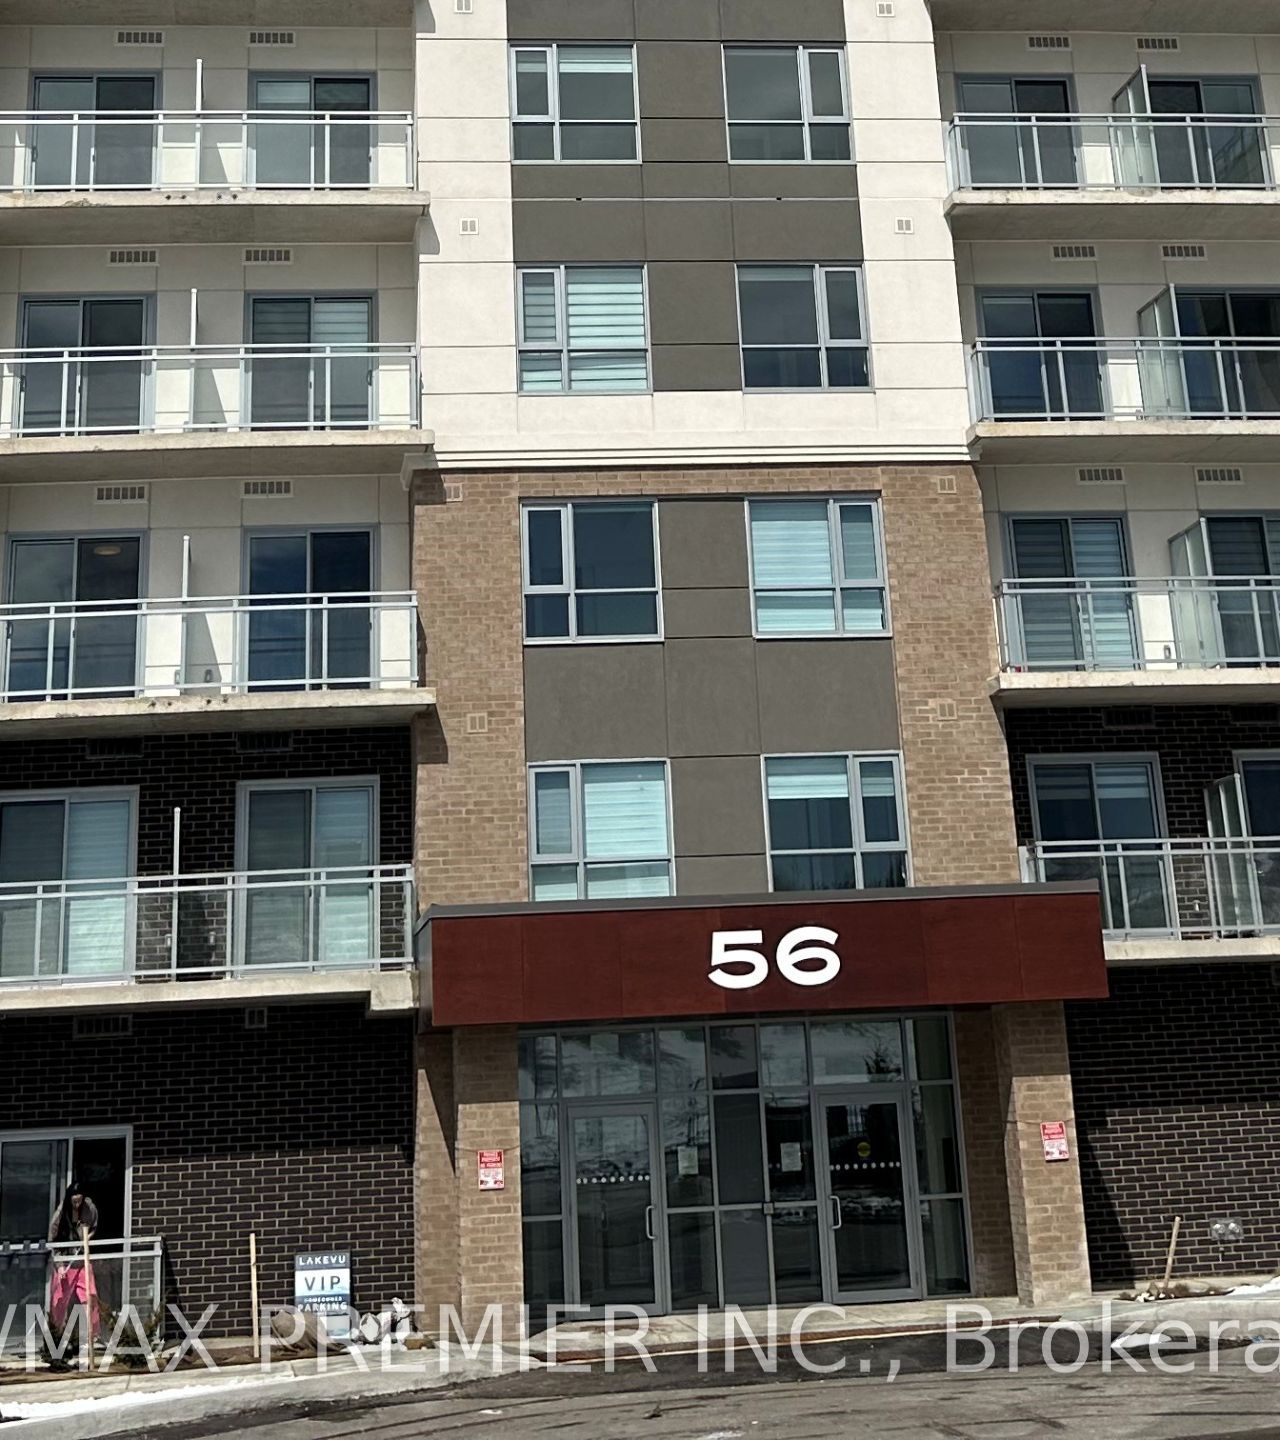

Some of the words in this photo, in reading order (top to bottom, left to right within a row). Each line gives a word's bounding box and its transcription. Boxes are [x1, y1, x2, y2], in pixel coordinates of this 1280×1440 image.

[708, 926, 841, 989] 56
[299, 1255, 346, 1266] LAKEVU
[304, 1275, 341, 1291] VIP
[297, 1301, 348, 1313] PARKING
